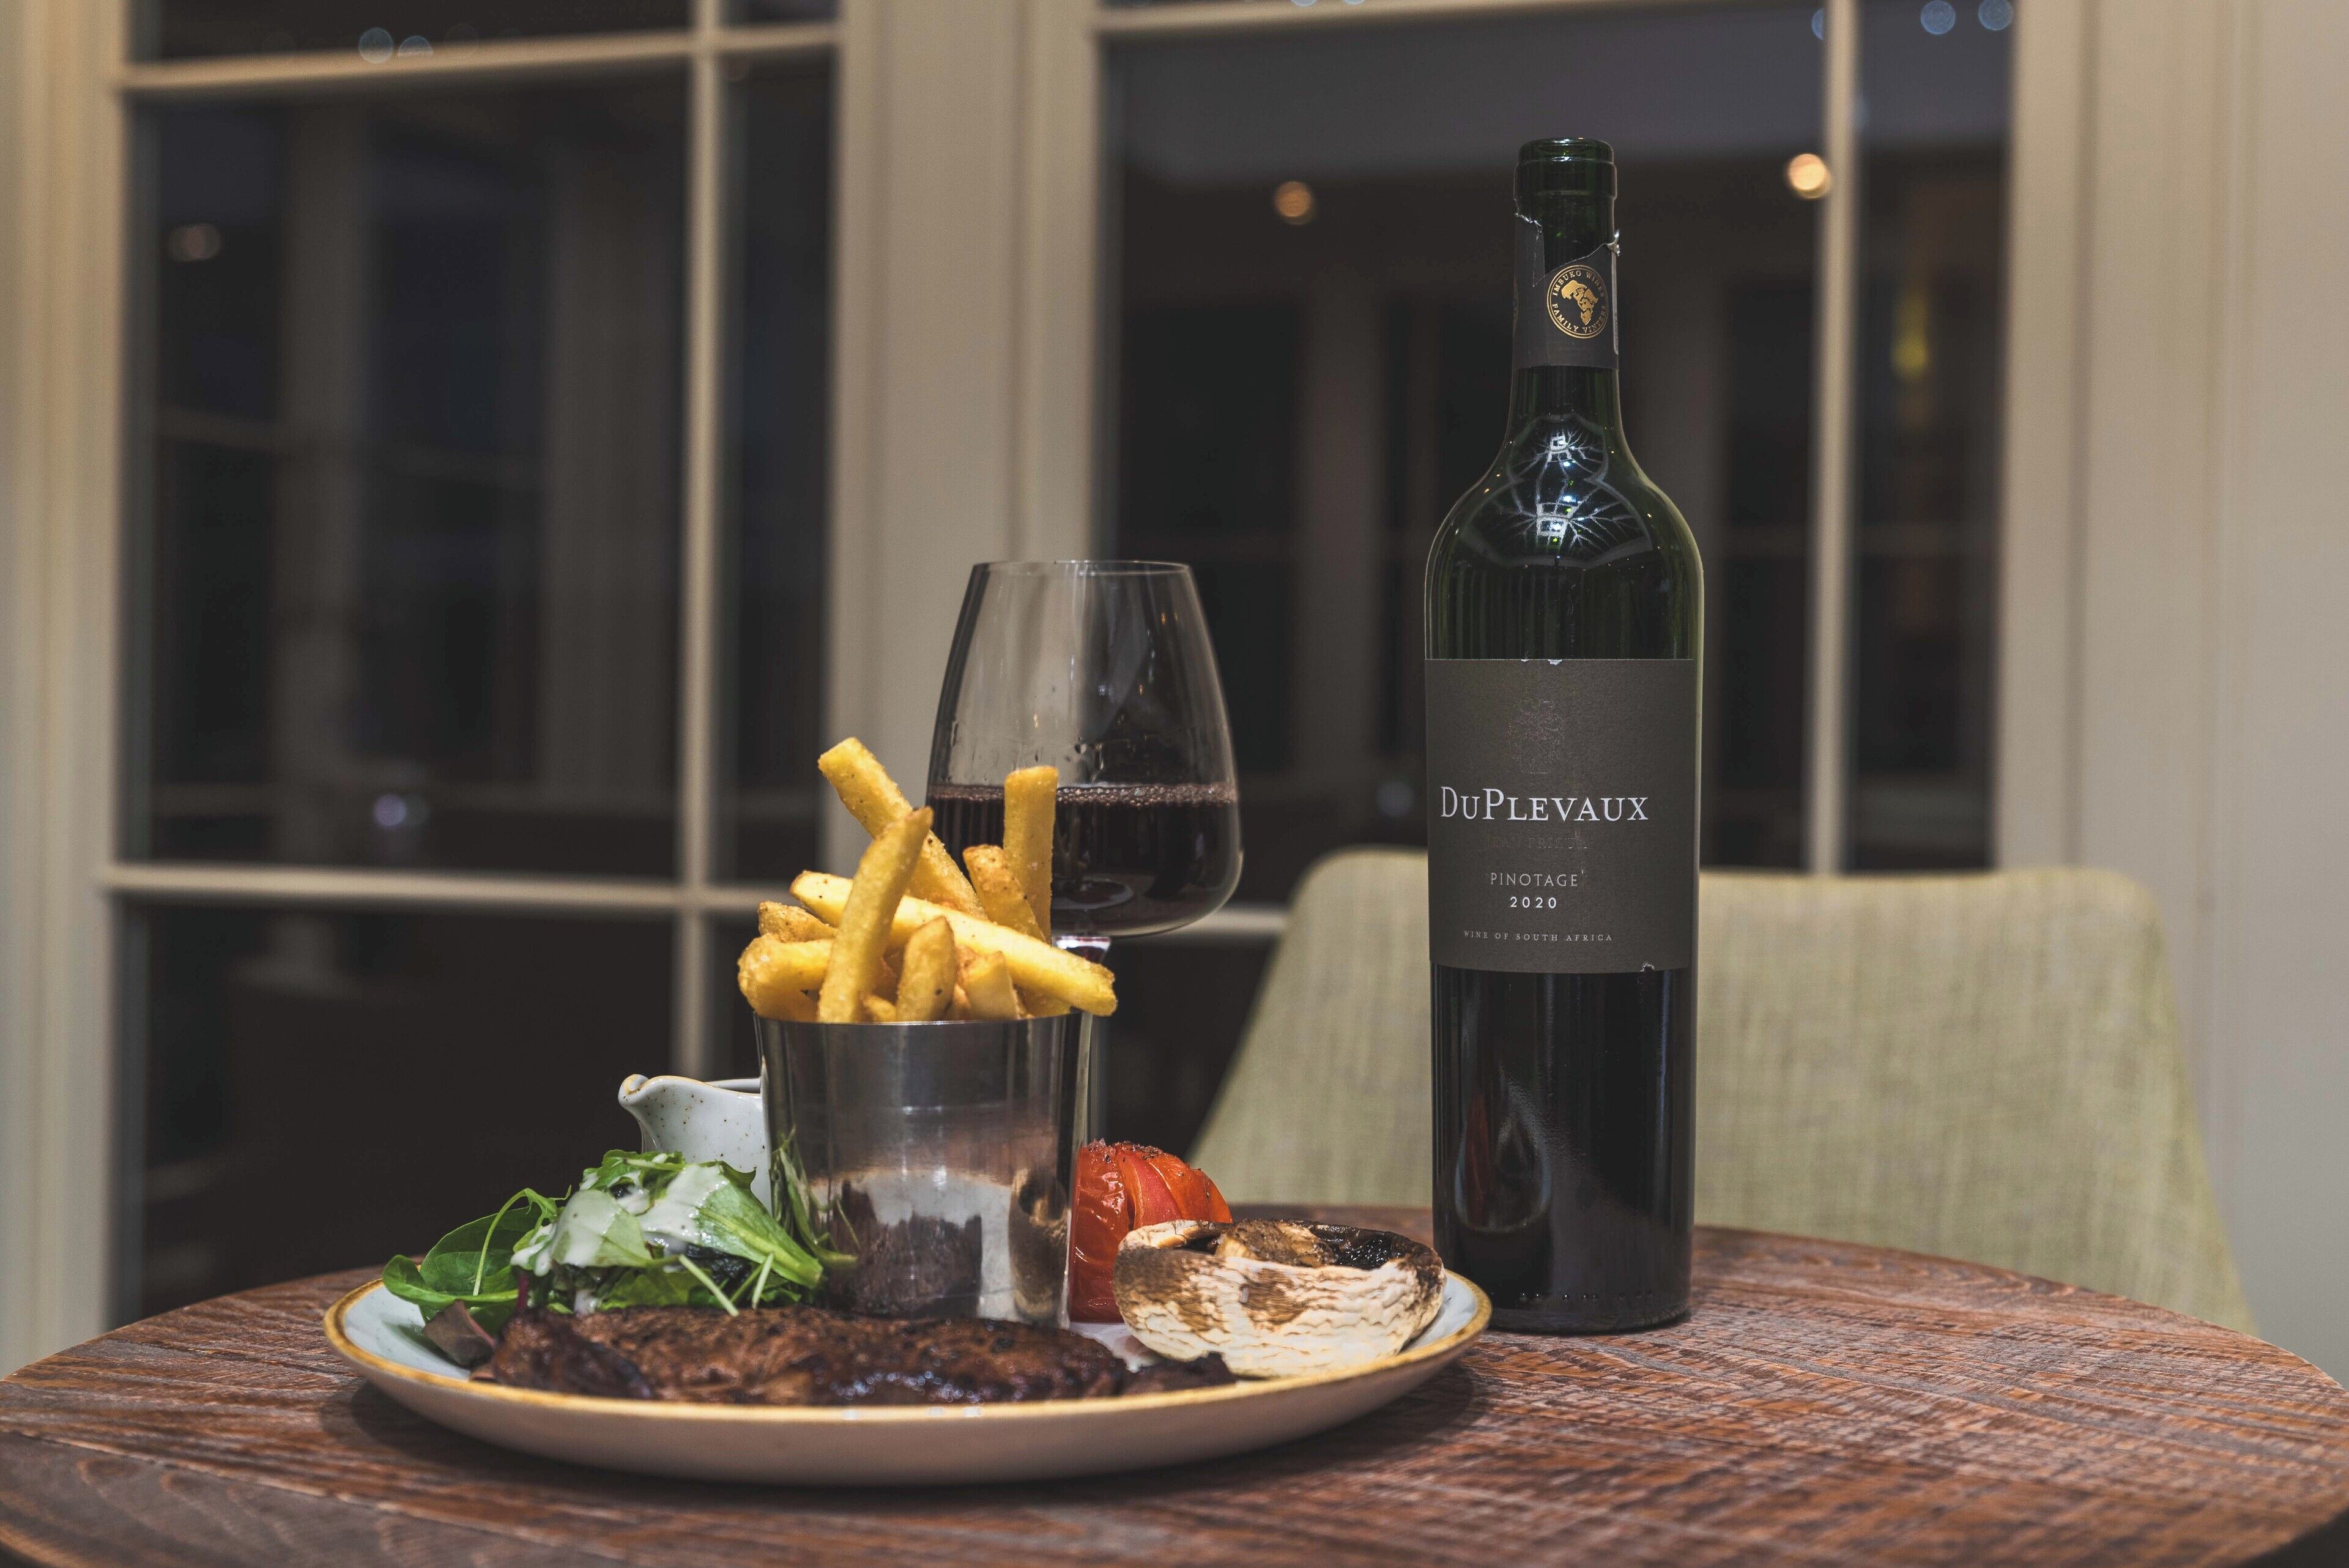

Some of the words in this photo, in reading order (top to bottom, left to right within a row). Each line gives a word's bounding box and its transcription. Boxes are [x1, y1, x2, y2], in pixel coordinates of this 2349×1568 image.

[1552, 270, 1581, 296] IMBUKO
[1552, 303, 1579, 332] FAMILY
[1490, 872, 1578, 887] PINOTAGE
[1510, 896, 1557, 909] 2020
[1464, 930, 1488, 939] WINE
